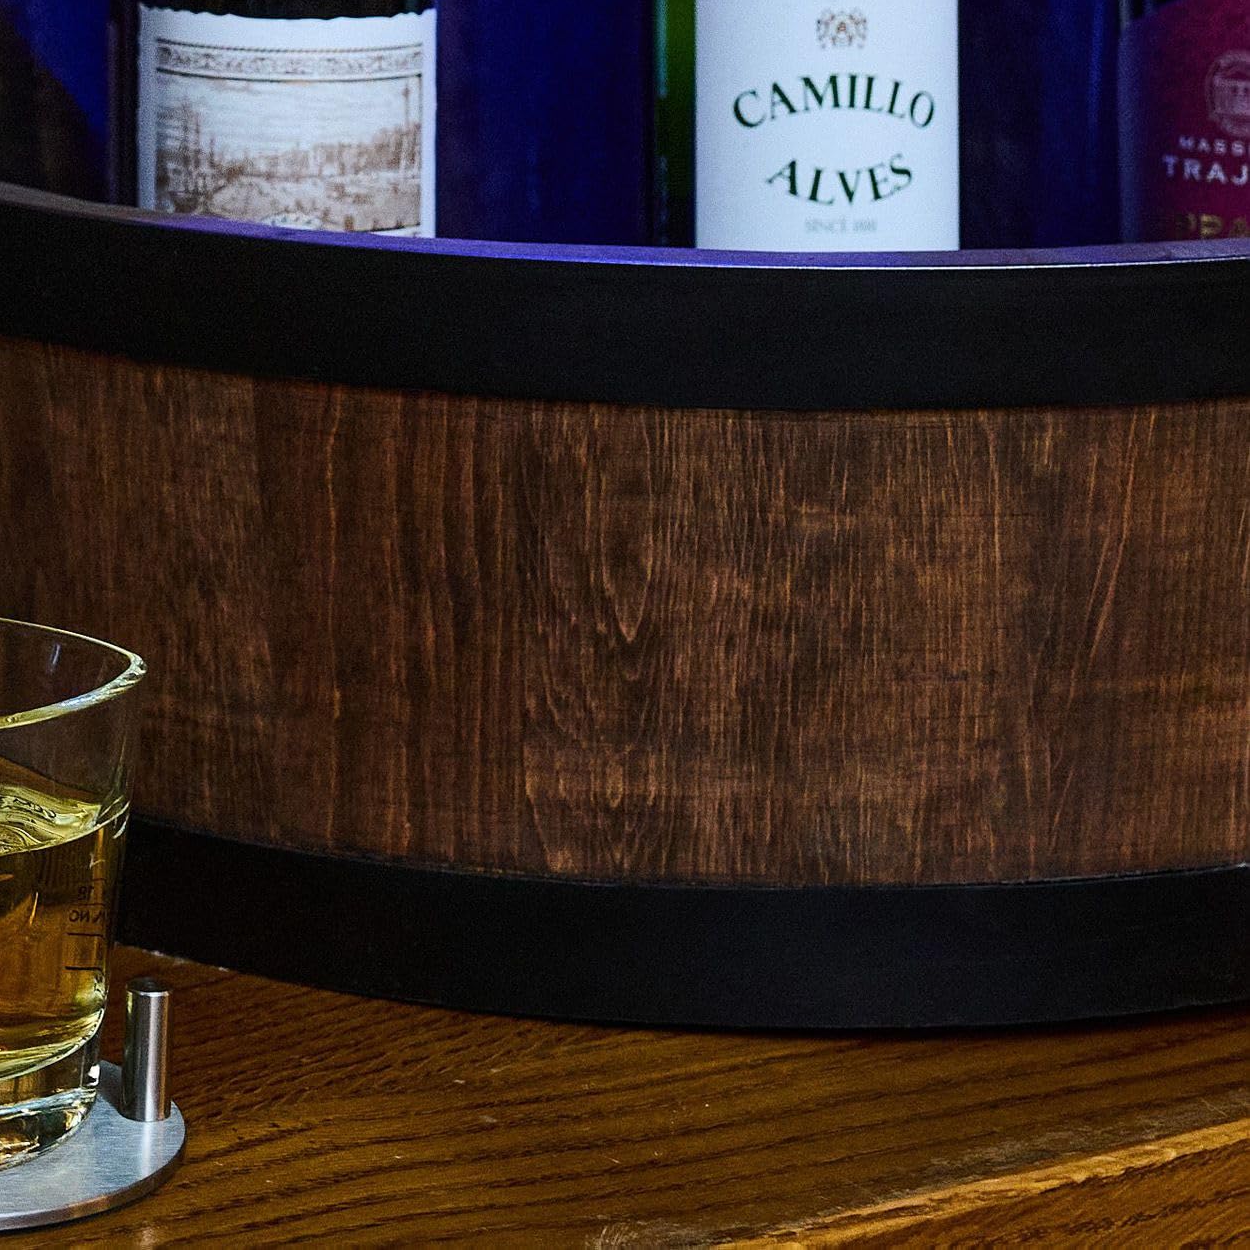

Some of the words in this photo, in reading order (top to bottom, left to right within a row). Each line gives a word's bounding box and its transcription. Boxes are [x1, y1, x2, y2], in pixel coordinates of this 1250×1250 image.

[733, 72, 935, 129] CAMILLO
[1178, 135, 1250, 158] MASS
[766, 152, 913, 207] ALVES
